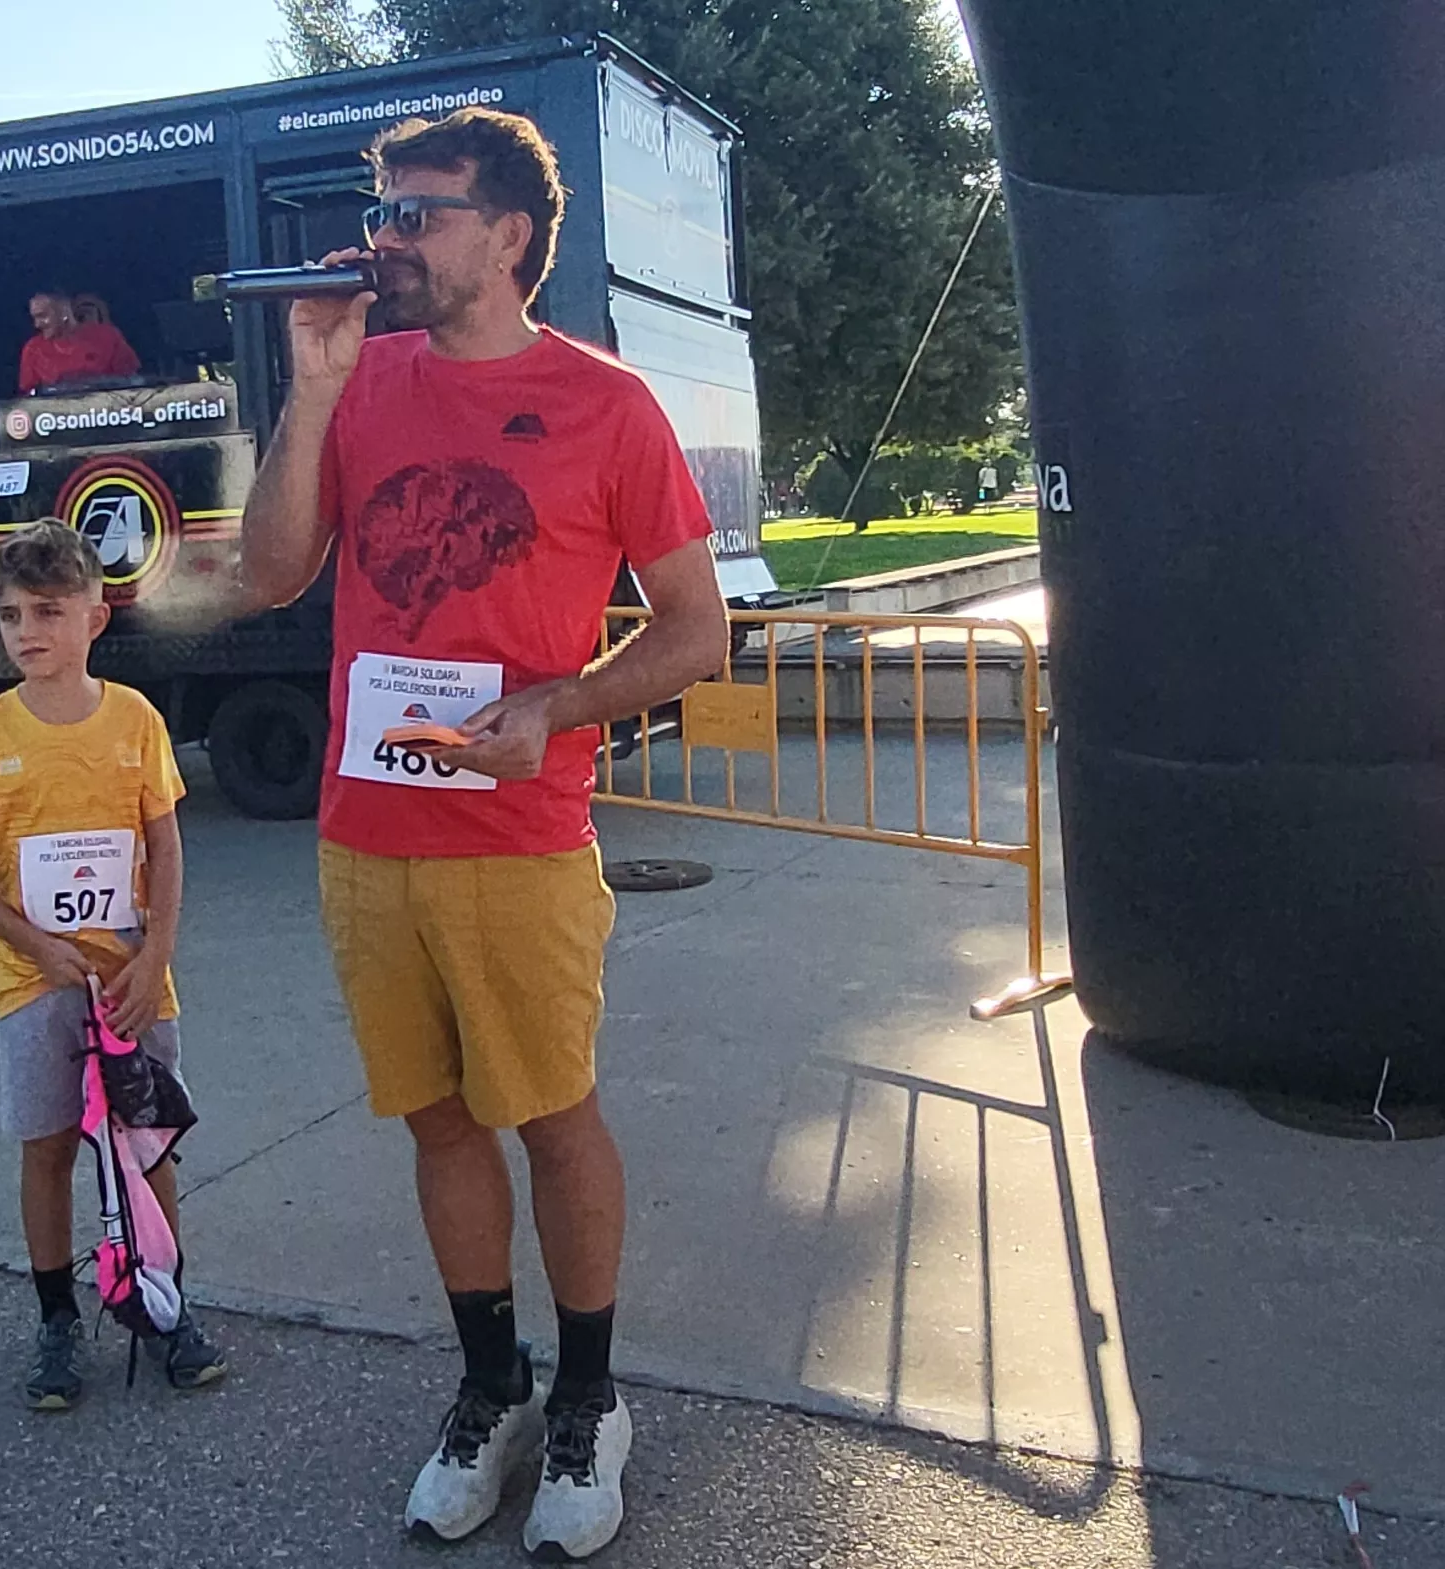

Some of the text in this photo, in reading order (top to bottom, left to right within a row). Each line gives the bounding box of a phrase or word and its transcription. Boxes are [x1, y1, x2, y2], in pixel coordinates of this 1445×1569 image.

[277, 87, 504, 132] #elcamiondelcachondeo
[619, 98, 665, 159] DISCO
[34, 397, 226, 437] @sonido54_official
[391, 664, 419, 679] MARCHA
[420, 667, 461, 682] SOLIDARIA
[393, 680, 437, 696] ESCLEROSIS
[54, 888, 116, 924] 507
